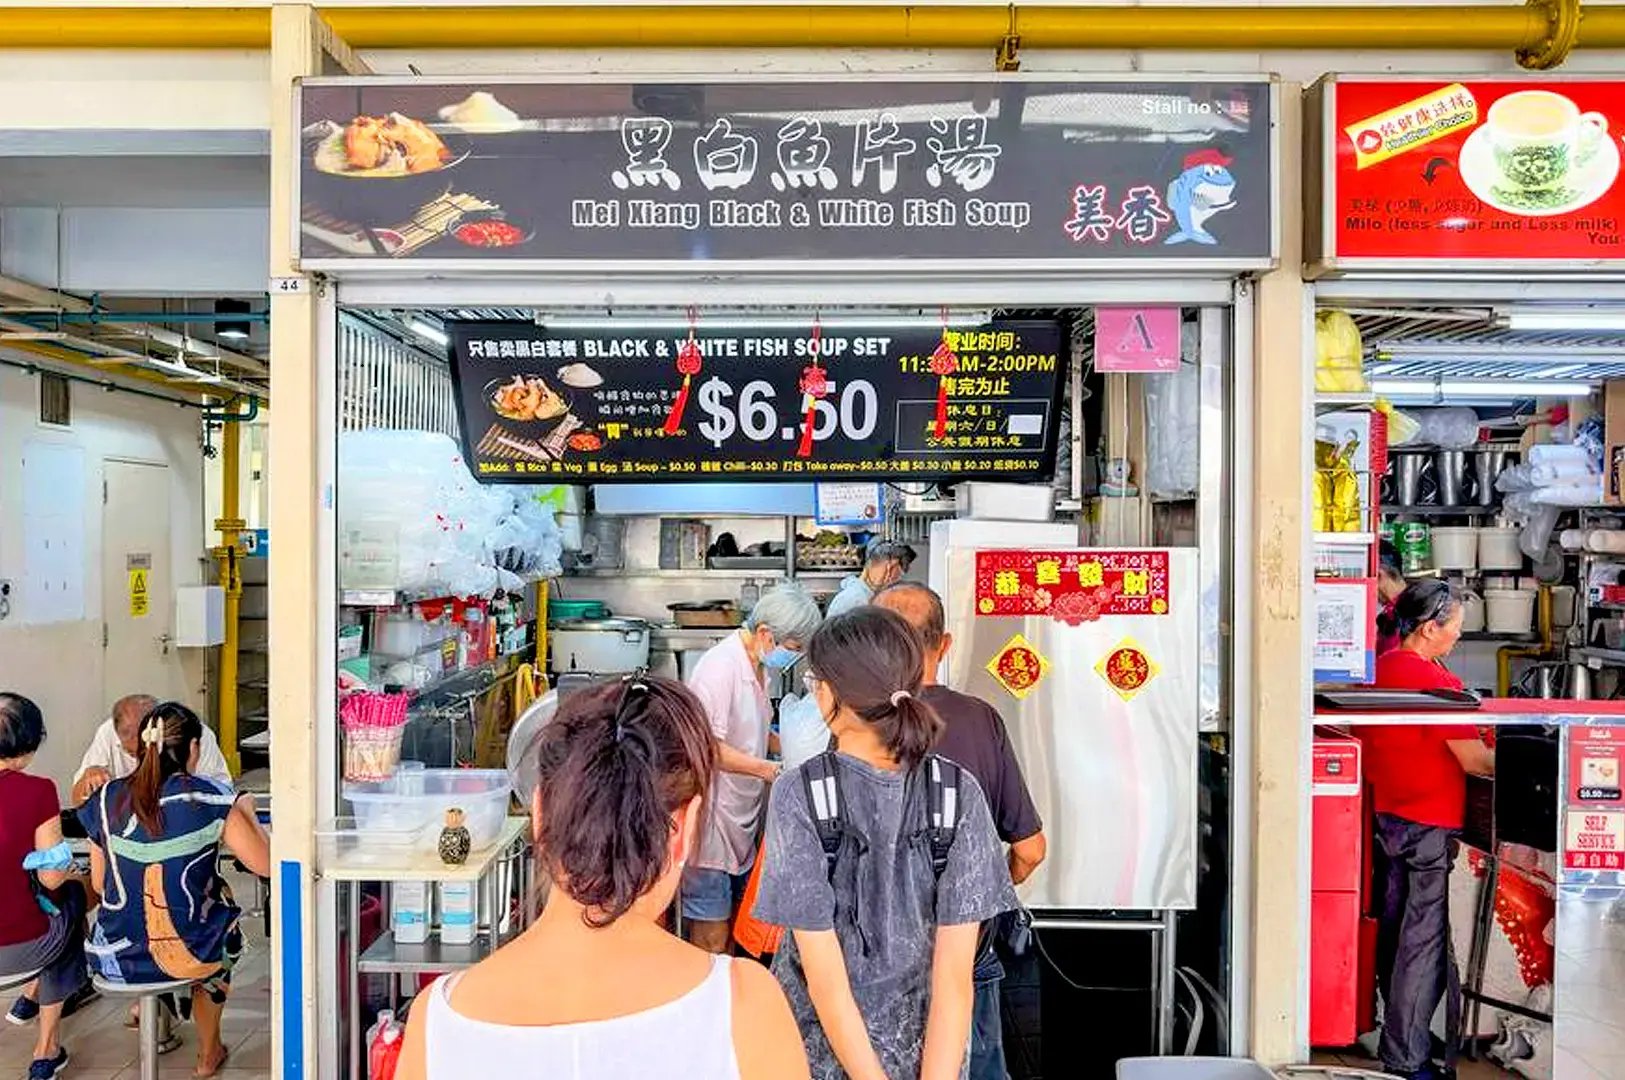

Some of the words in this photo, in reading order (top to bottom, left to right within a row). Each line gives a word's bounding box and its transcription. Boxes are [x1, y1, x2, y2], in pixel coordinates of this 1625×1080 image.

[1142, 99, 1182, 114] Stall
[1187, 102, 1211, 114] no
[611, 114, 1003, 194] 黑白魚片湯
[572, 200, 619, 227] Mei
[627, 200, 700, 229] Xiang
[710, 200, 781, 227] Black
[790, 203, 809, 226] &
[819, 200, 894, 227] White
[904, 200, 956, 227] Fish
[965, 200, 1030, 229] Soup
[1064, 184, 1170, 242] 美香
[1346, 217, 1382, 231] Milo
[1388, 217, 1430, 232] (less
[1491, 217, 1521, 231] and
[1528, 217, 1568, 231] Less
[1575, 217, 1619, 232] milk)
[280, 279, 299, 291] 44
[583, 339, 650, 358] BLACK
[655, 339, 669, 357] &
[744, 338, 788, 357] FISH
[794, 338, 848, 357] SOUP
[853, 338, 891, 357] SET
[698, 376, 878, 448] $6.50
[527, 462, 547, 473] Rice
[564, 463, 582, 474] Veg
[600, 461, 618, 474] Egg
[635, 461, 659, 474] Soup
[669, 461, 696, 473] $0.50
[806, 461, 828, 473] Take
